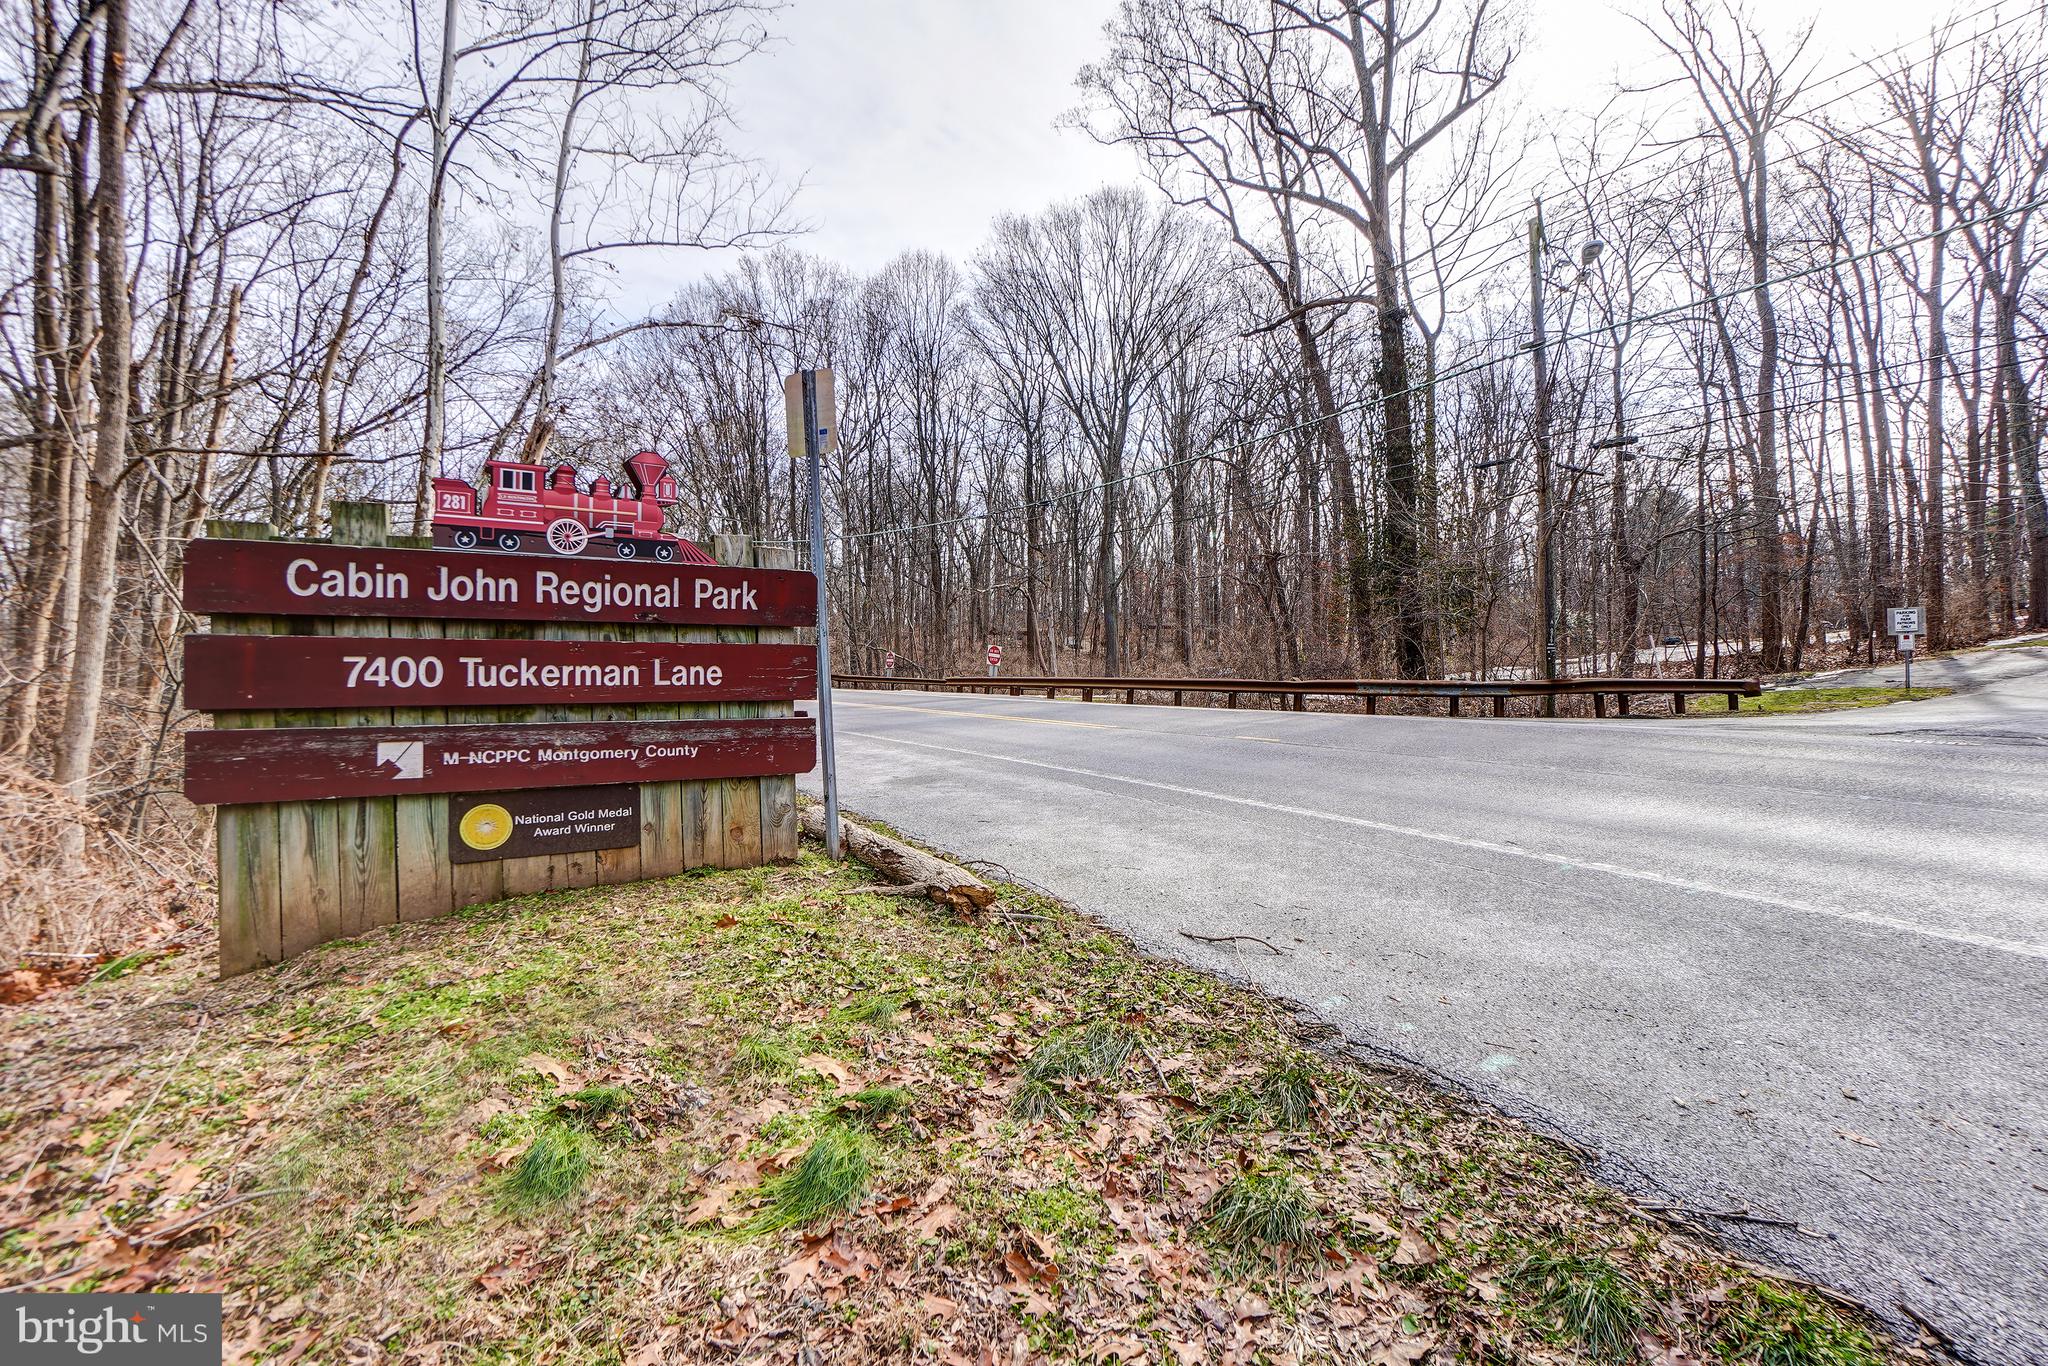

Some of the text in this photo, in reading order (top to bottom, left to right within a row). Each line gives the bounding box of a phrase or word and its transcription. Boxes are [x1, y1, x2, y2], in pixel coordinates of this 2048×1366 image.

[442, 493, 467, 511] 281
[286, 558, 759, 613] Cabin John Regional Park
[342, 656, 724, 688] 7400 Tuckerman Lane
[538, 748, 640, 764] Montgomery
[645, 744, 700, 761] County
[514, 806, 633, 826] National Gold Medal
[533, 821, 616, 838] Award Winner
